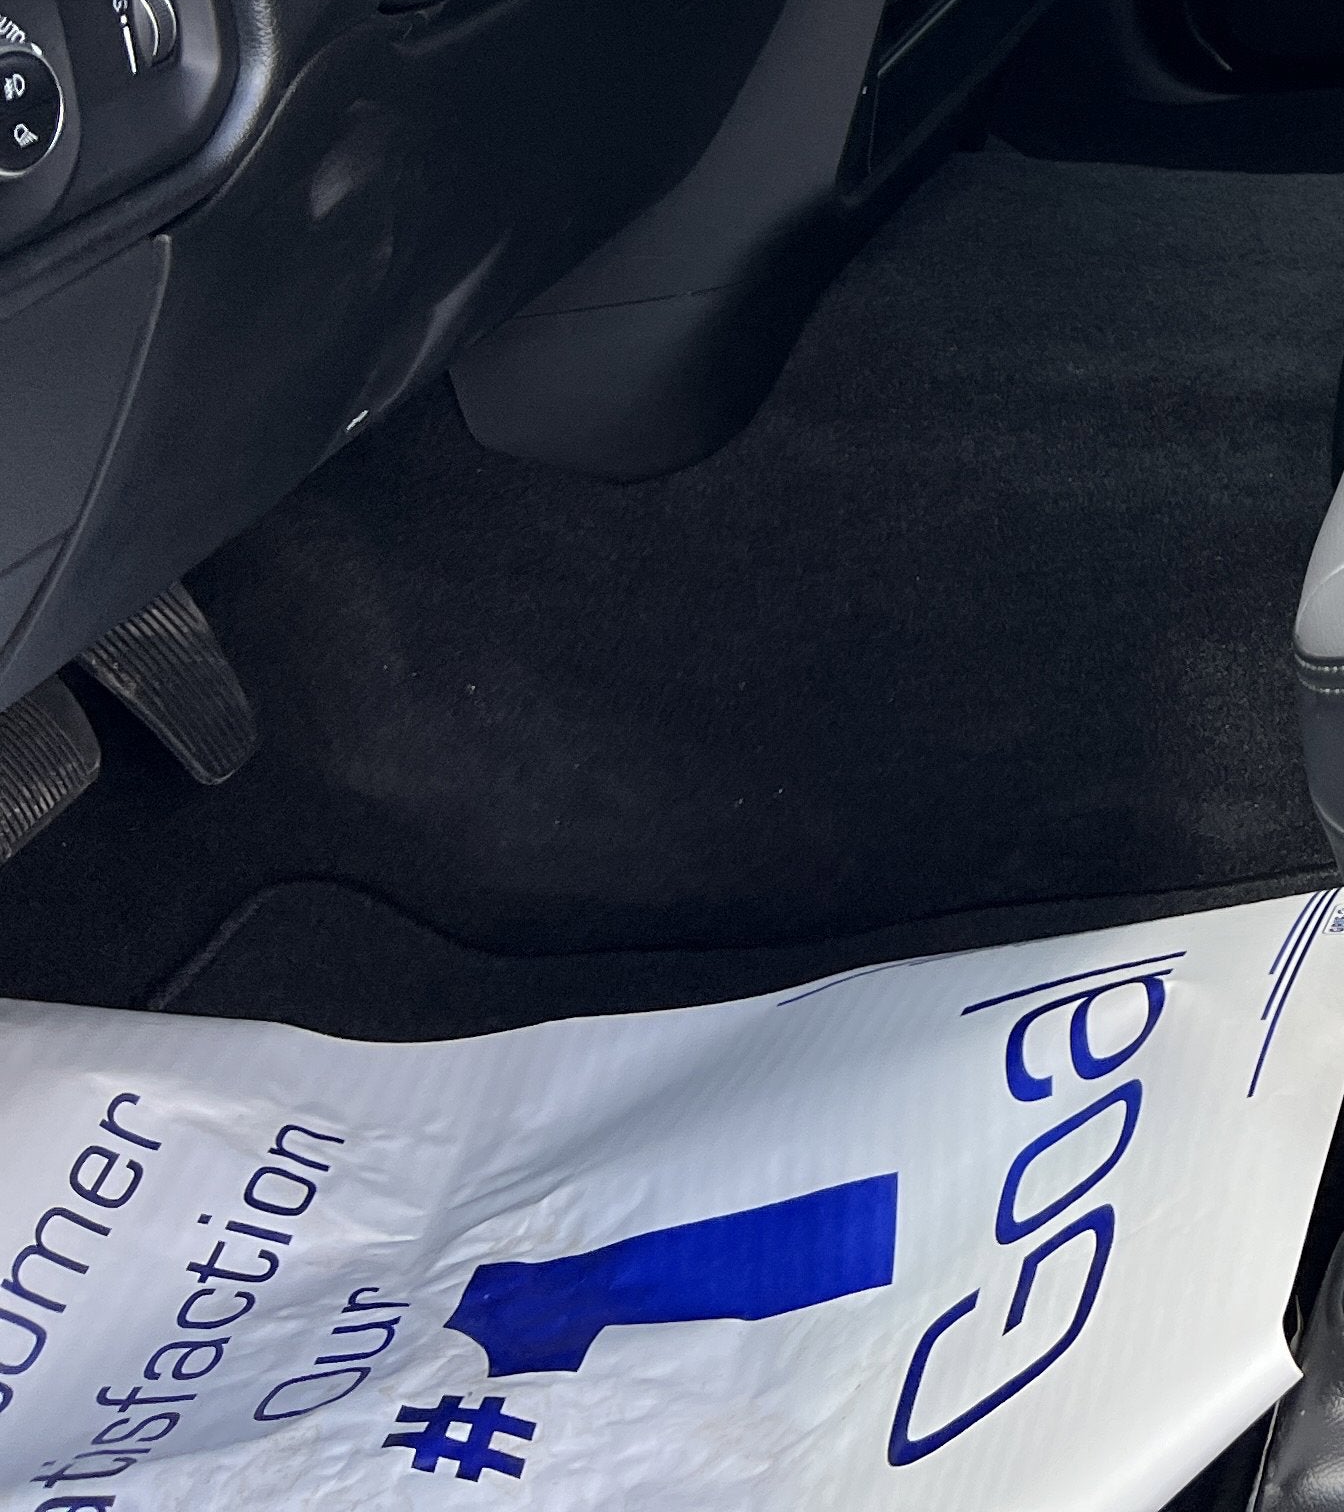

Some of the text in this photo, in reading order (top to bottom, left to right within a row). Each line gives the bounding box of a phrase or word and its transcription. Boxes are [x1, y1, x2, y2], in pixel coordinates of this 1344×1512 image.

[0, 15, 27, 45] UTO
[886, 950, 1189, 1468] Goal
[252, 1286, 410, 1422] Our
